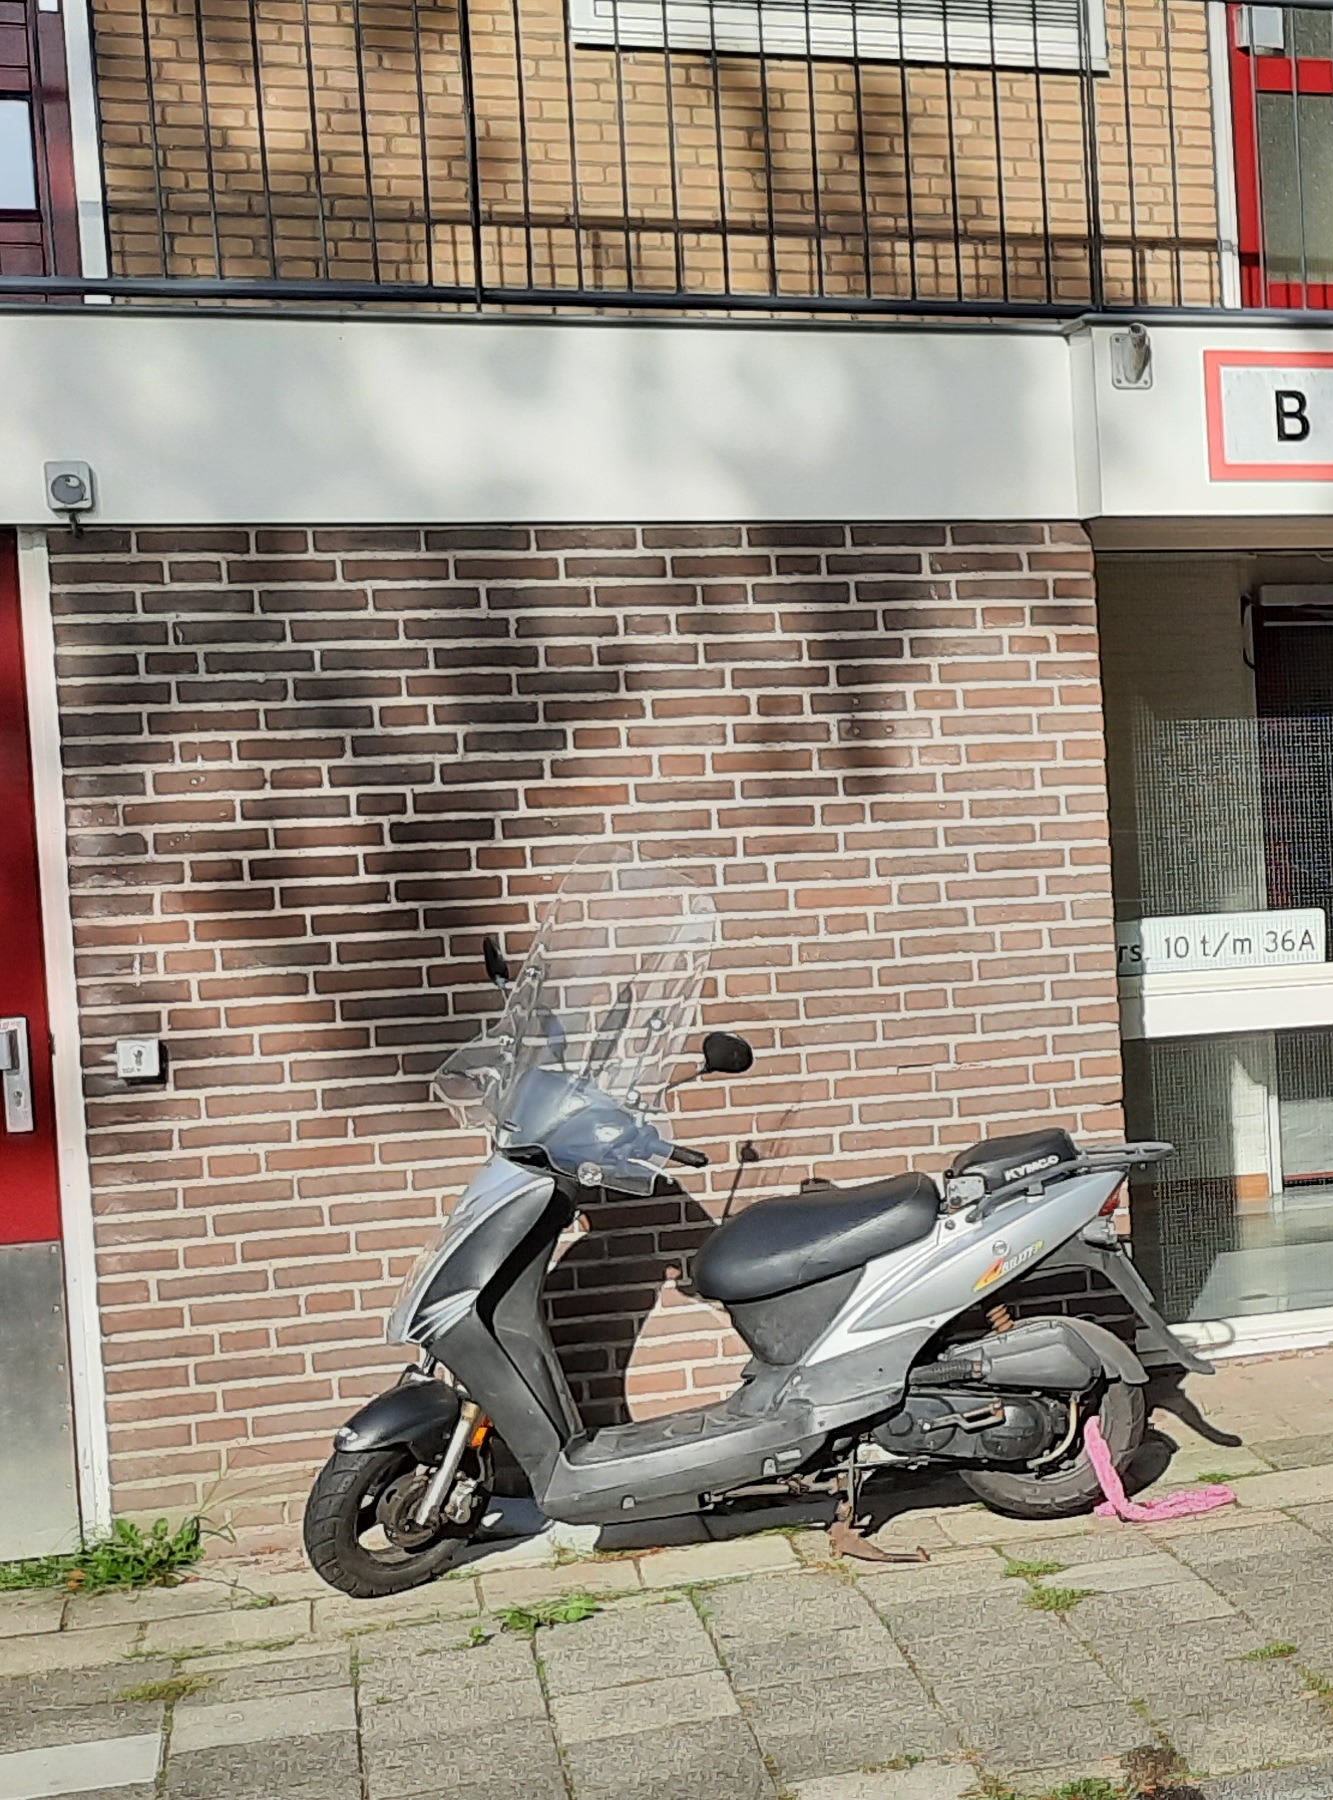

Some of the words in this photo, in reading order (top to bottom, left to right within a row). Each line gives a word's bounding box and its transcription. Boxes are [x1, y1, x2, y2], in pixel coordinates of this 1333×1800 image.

[1274, 389, 1311, 443] B
[1165, 935, 1190, 959] 10
[1200, 931, 1252, 958] t/m
[1264, 929, 1316, 952] 36A
[1004, 1154, 1060, 1182] KYMCO
